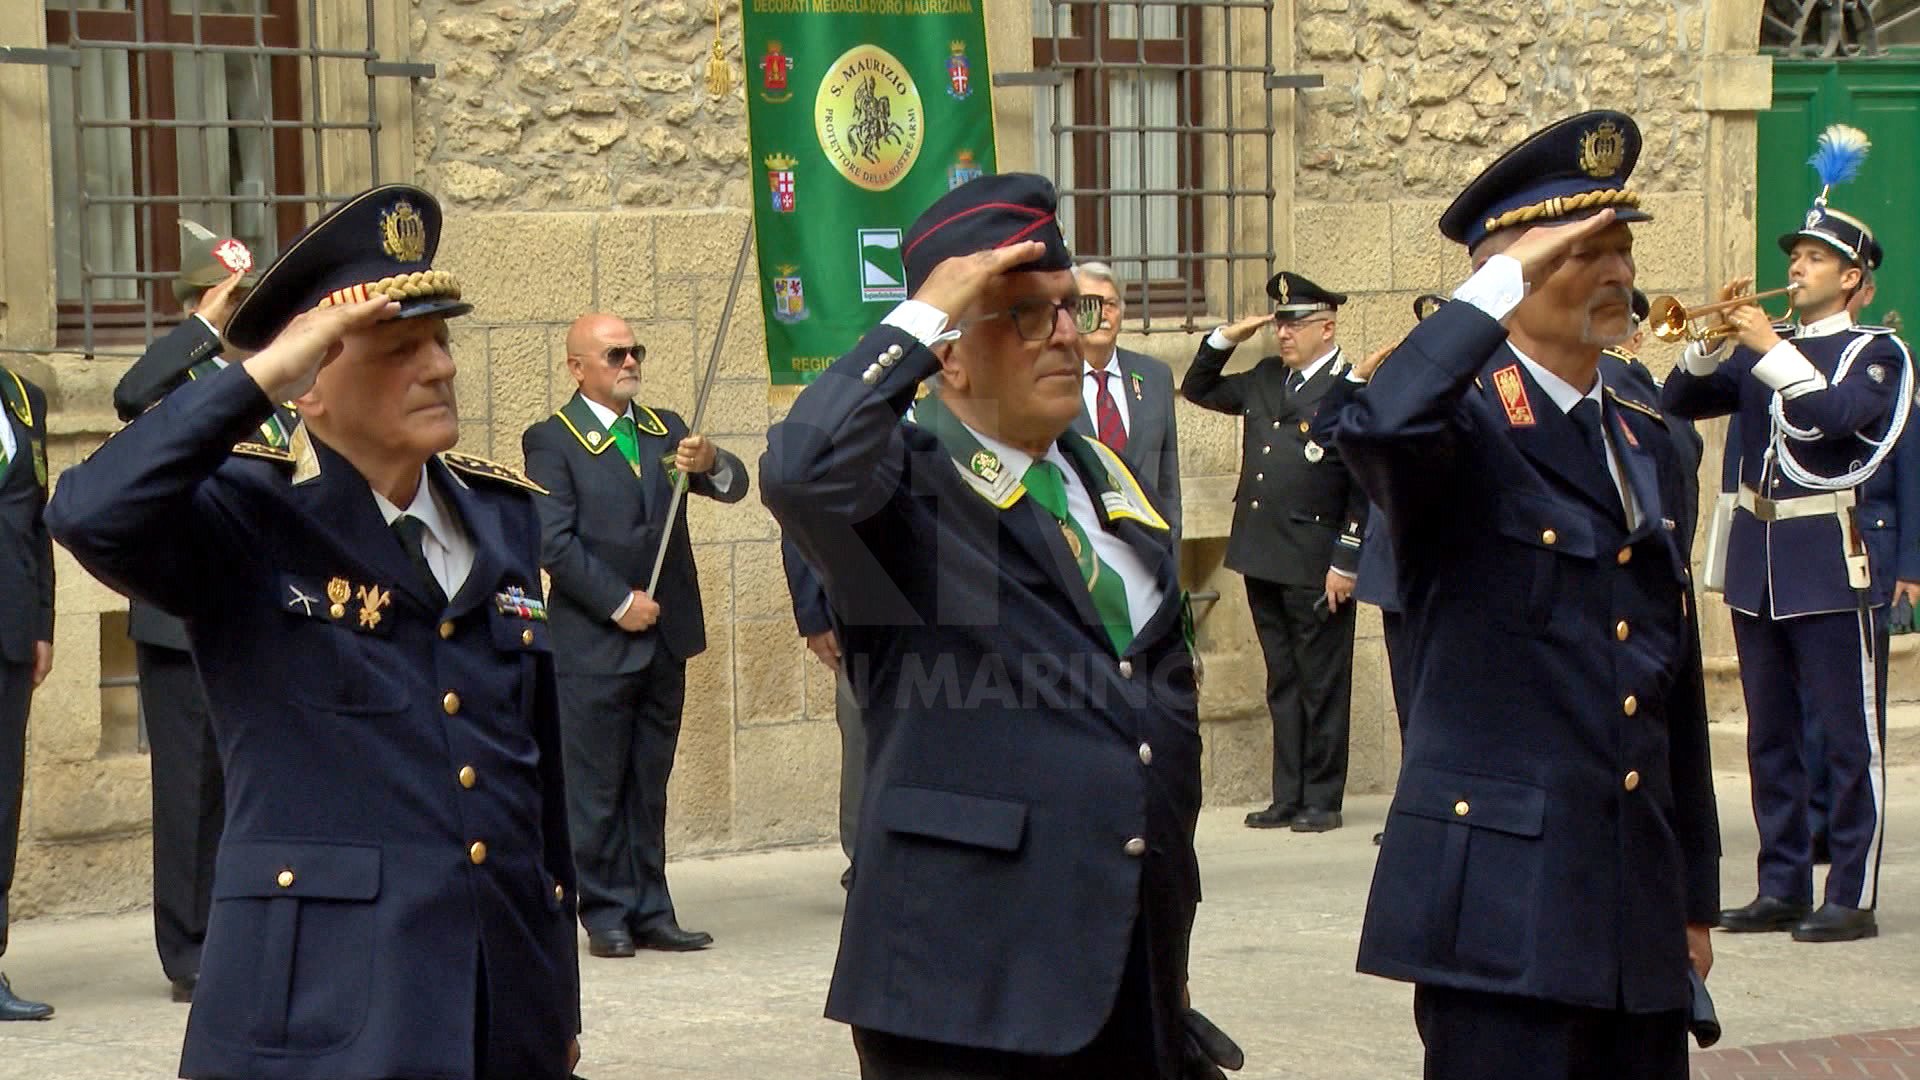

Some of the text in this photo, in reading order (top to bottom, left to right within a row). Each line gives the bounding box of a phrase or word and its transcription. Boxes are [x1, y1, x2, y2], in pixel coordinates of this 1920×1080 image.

[753, 0, 809, 13] DECORATI
[812, 0, 869, 13] MEDAGLIA
[904, 0, 973, 14] MAURIZIANA
[830, 58, 907, 98] S. MAURIZIO
[824, 107, 917, 183] PROTETTORE DELLE NOSTRE ARMI
[791, 356, 837, 372] REGIO
